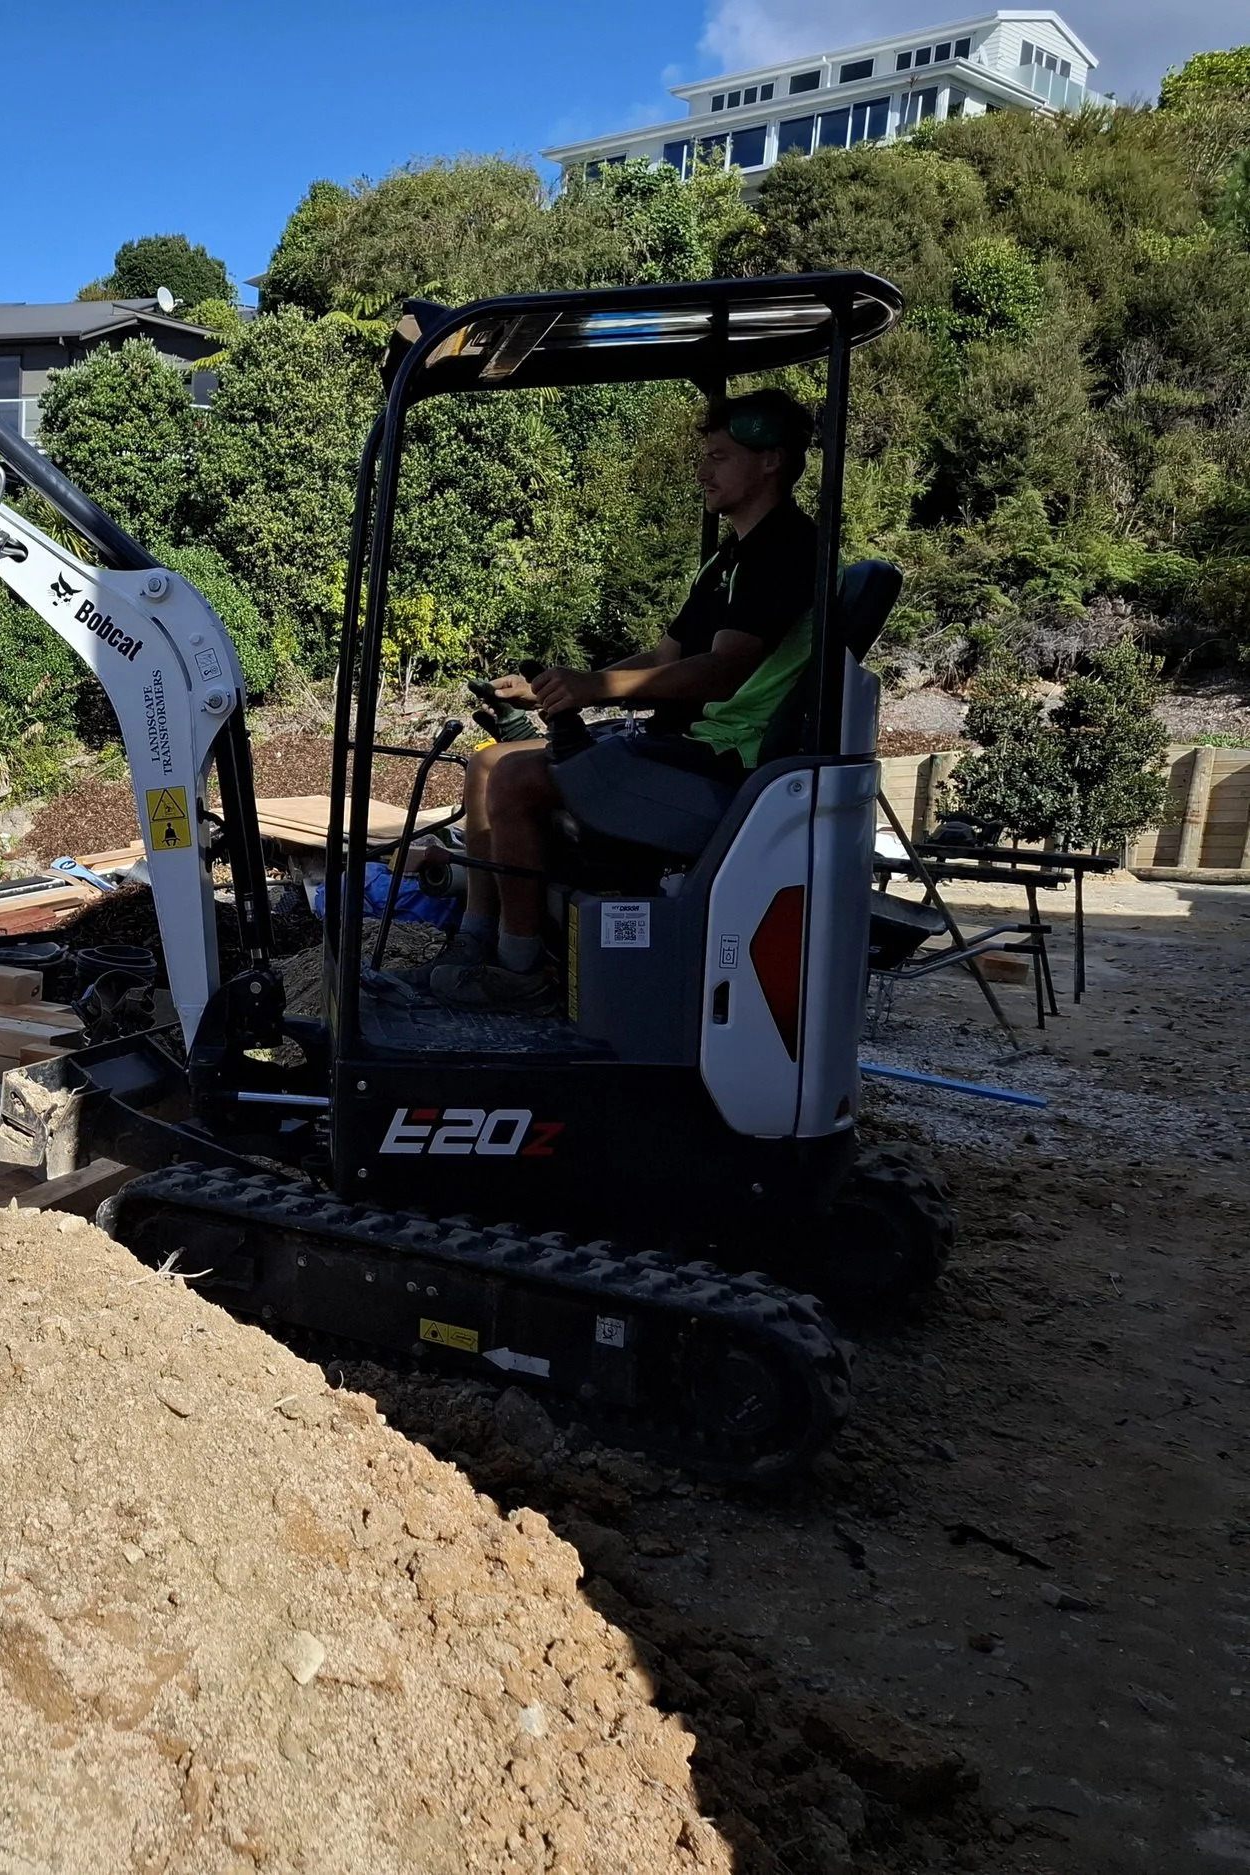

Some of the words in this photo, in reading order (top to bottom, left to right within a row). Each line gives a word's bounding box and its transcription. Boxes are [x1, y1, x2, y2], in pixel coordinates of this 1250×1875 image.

[74, 599, 143, 662] Bobcat
[143, 685, 161, 762] LANDSCAPE
[152, 669, 173, 776] TRANSFORMERS
